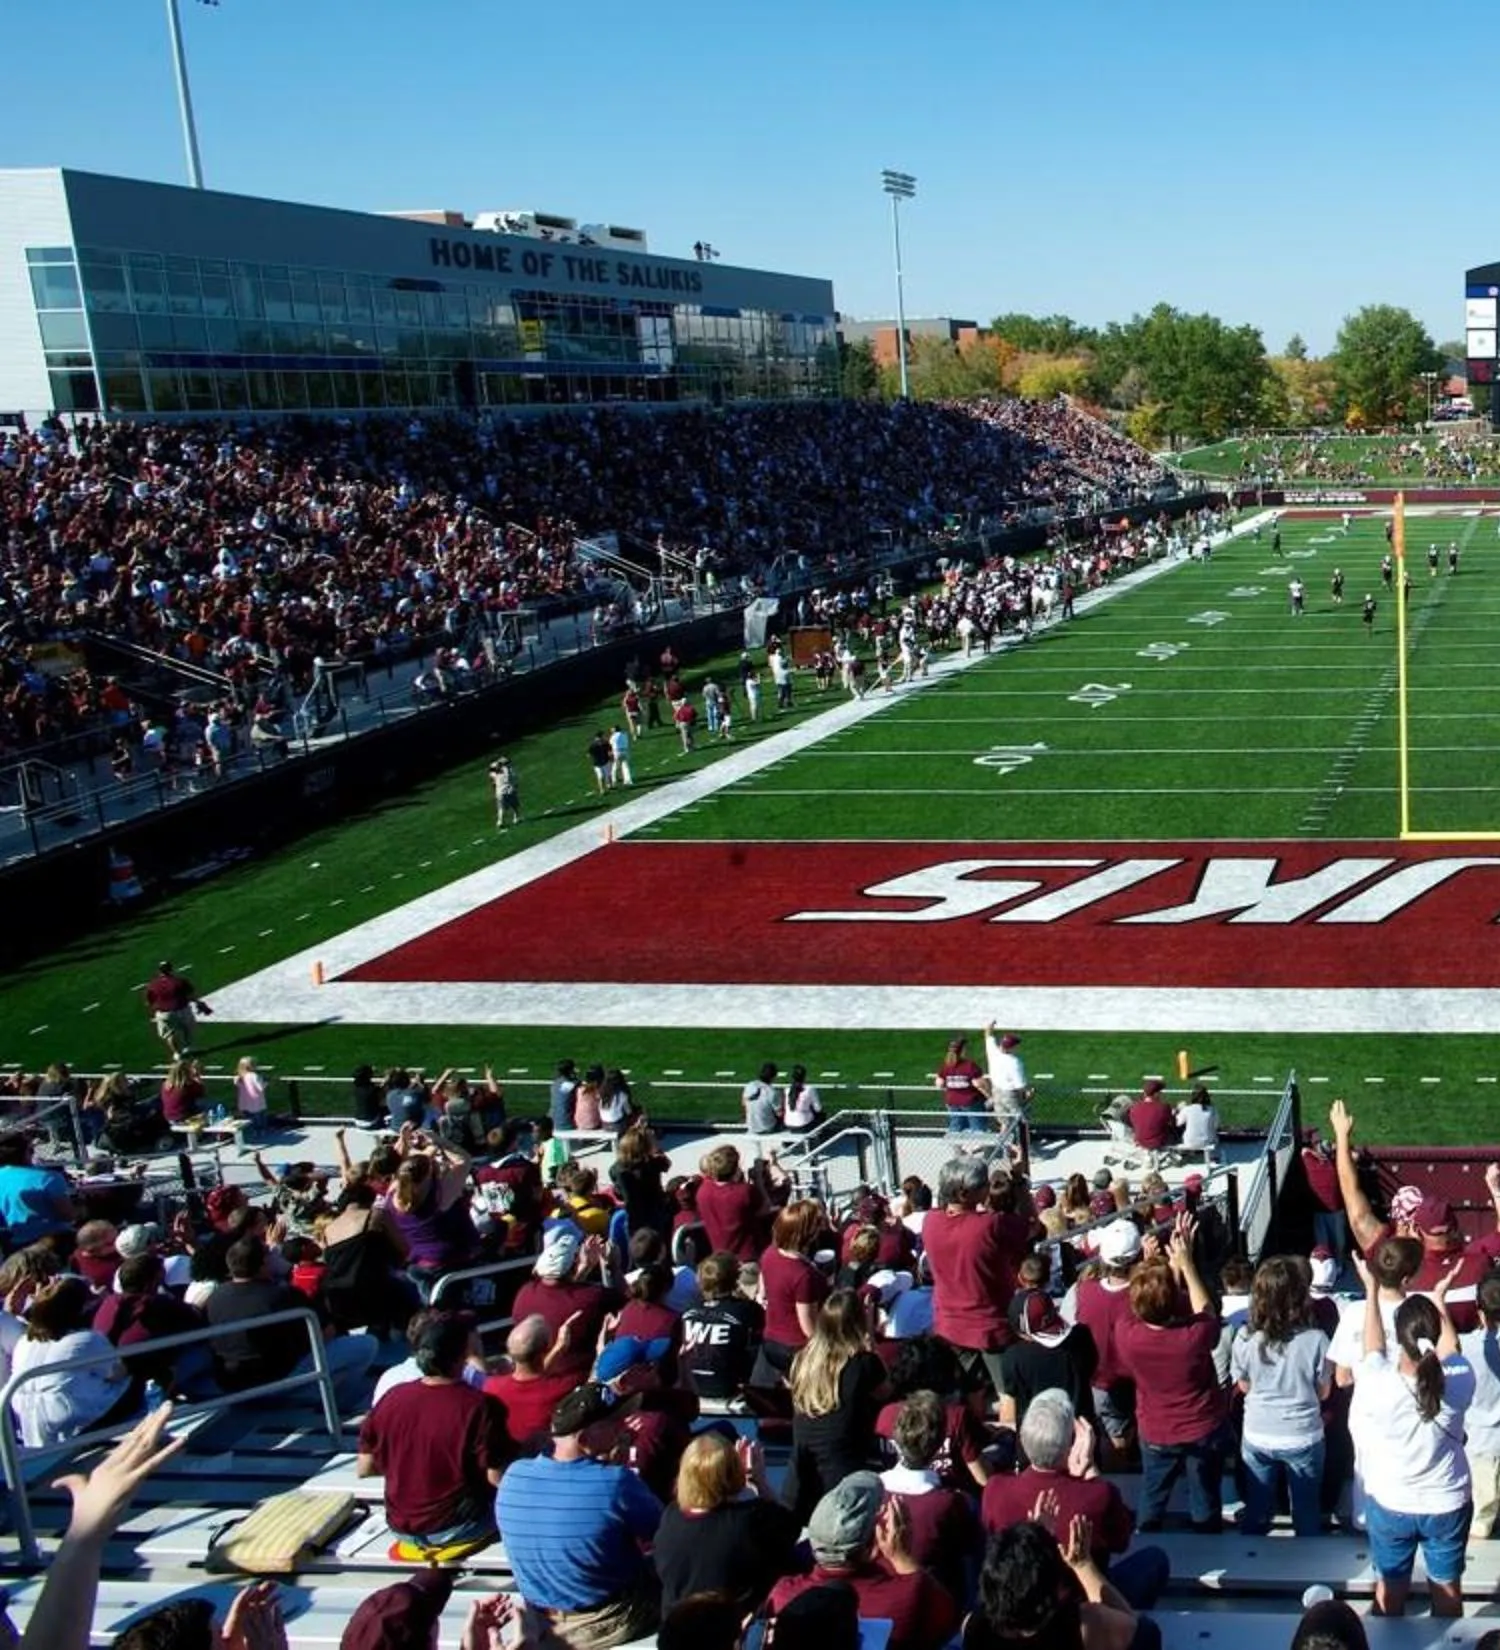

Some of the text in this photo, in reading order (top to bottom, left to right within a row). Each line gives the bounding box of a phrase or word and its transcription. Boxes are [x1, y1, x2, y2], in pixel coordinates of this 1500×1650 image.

[428, 238, 703, 293] HOME OF THE SALUKIS
[972, 741, 1048, 766] 10
[684, 1320, 731, 1345] WE
